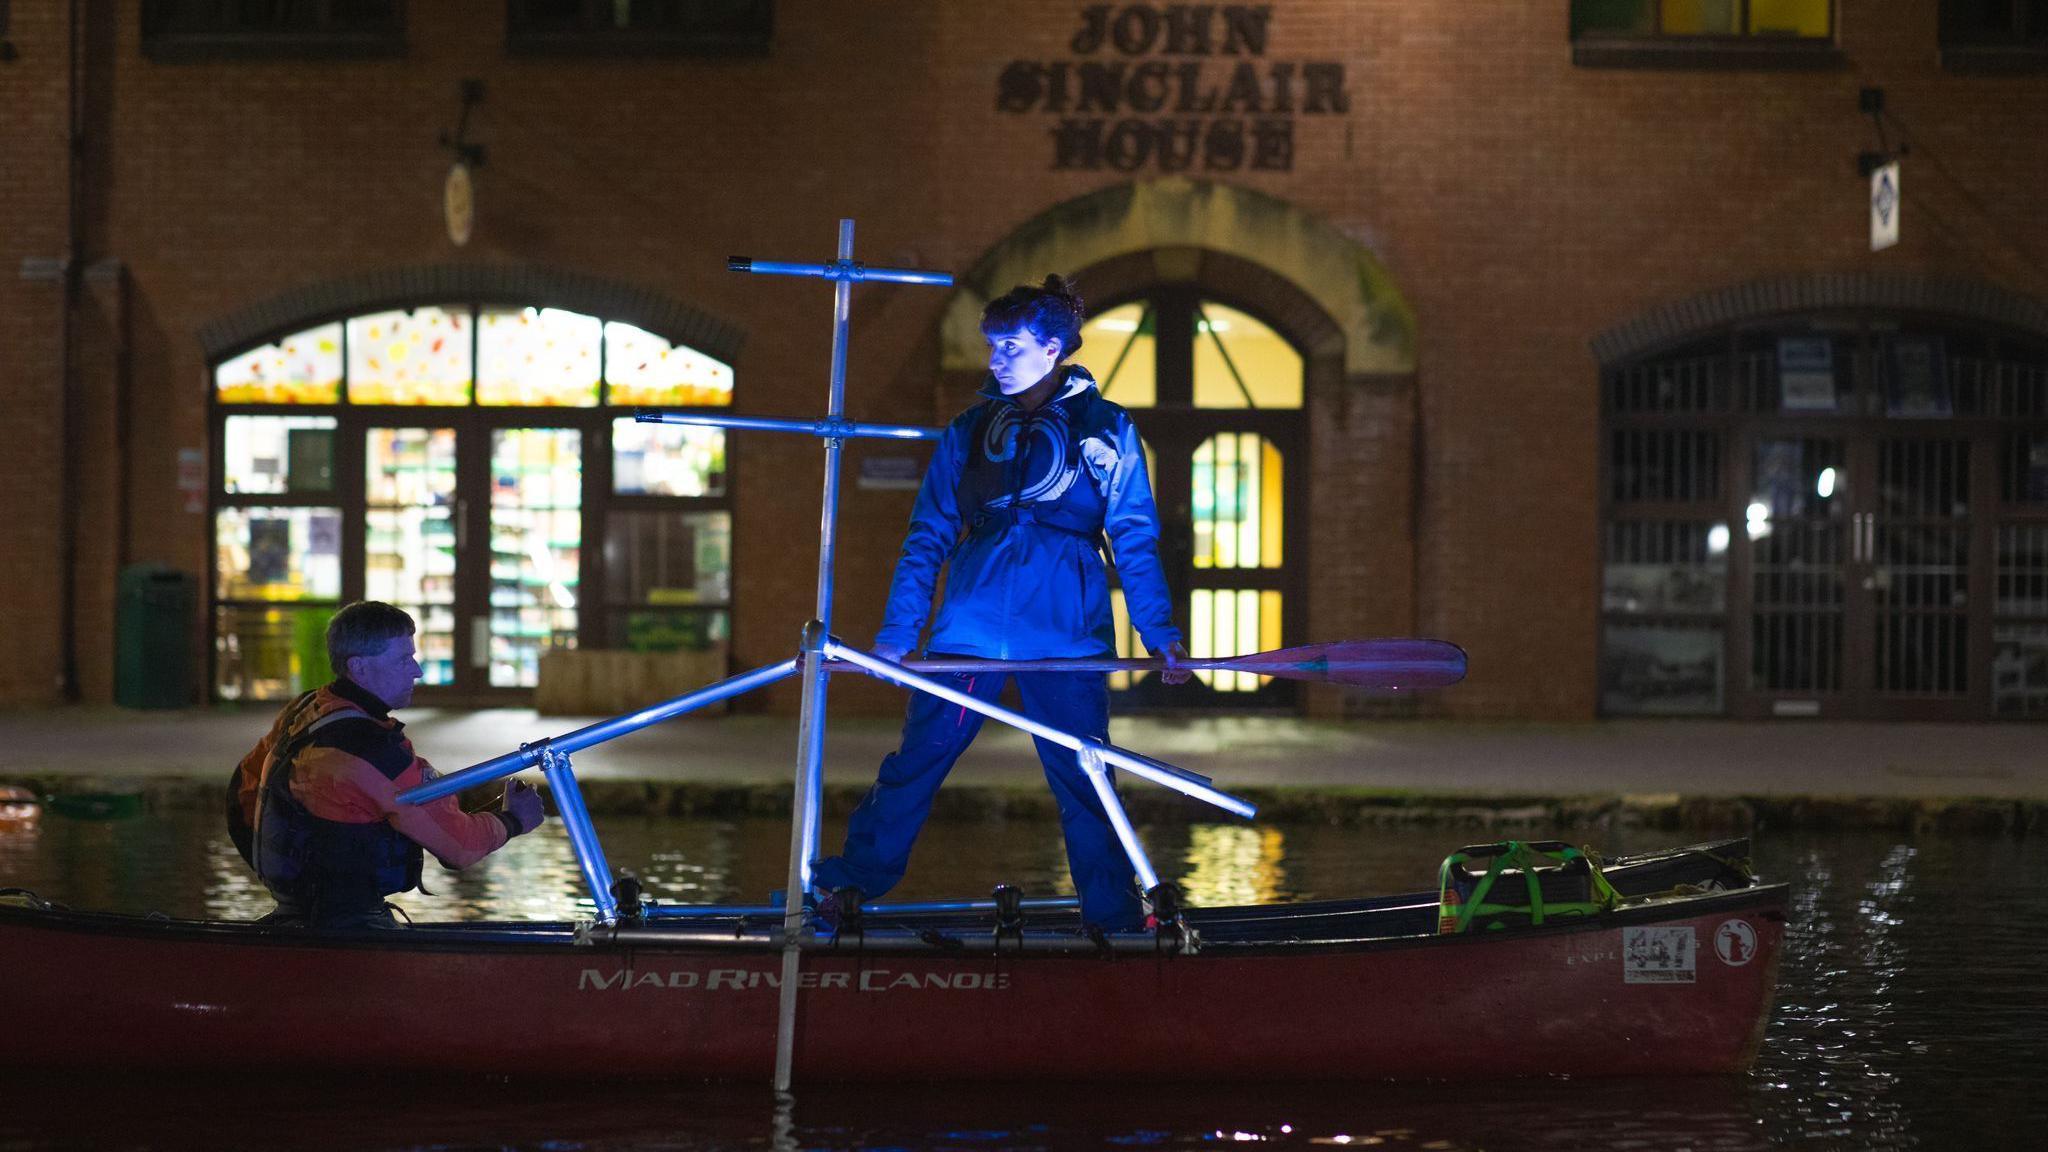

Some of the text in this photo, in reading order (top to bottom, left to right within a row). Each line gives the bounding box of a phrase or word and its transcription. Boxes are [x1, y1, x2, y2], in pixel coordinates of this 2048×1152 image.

[1071, 4, 1271, 55] JOHN
[999, 60, 1350, 114] SINCLAIR
[1051, 118, 1293, 171] HOUSE
